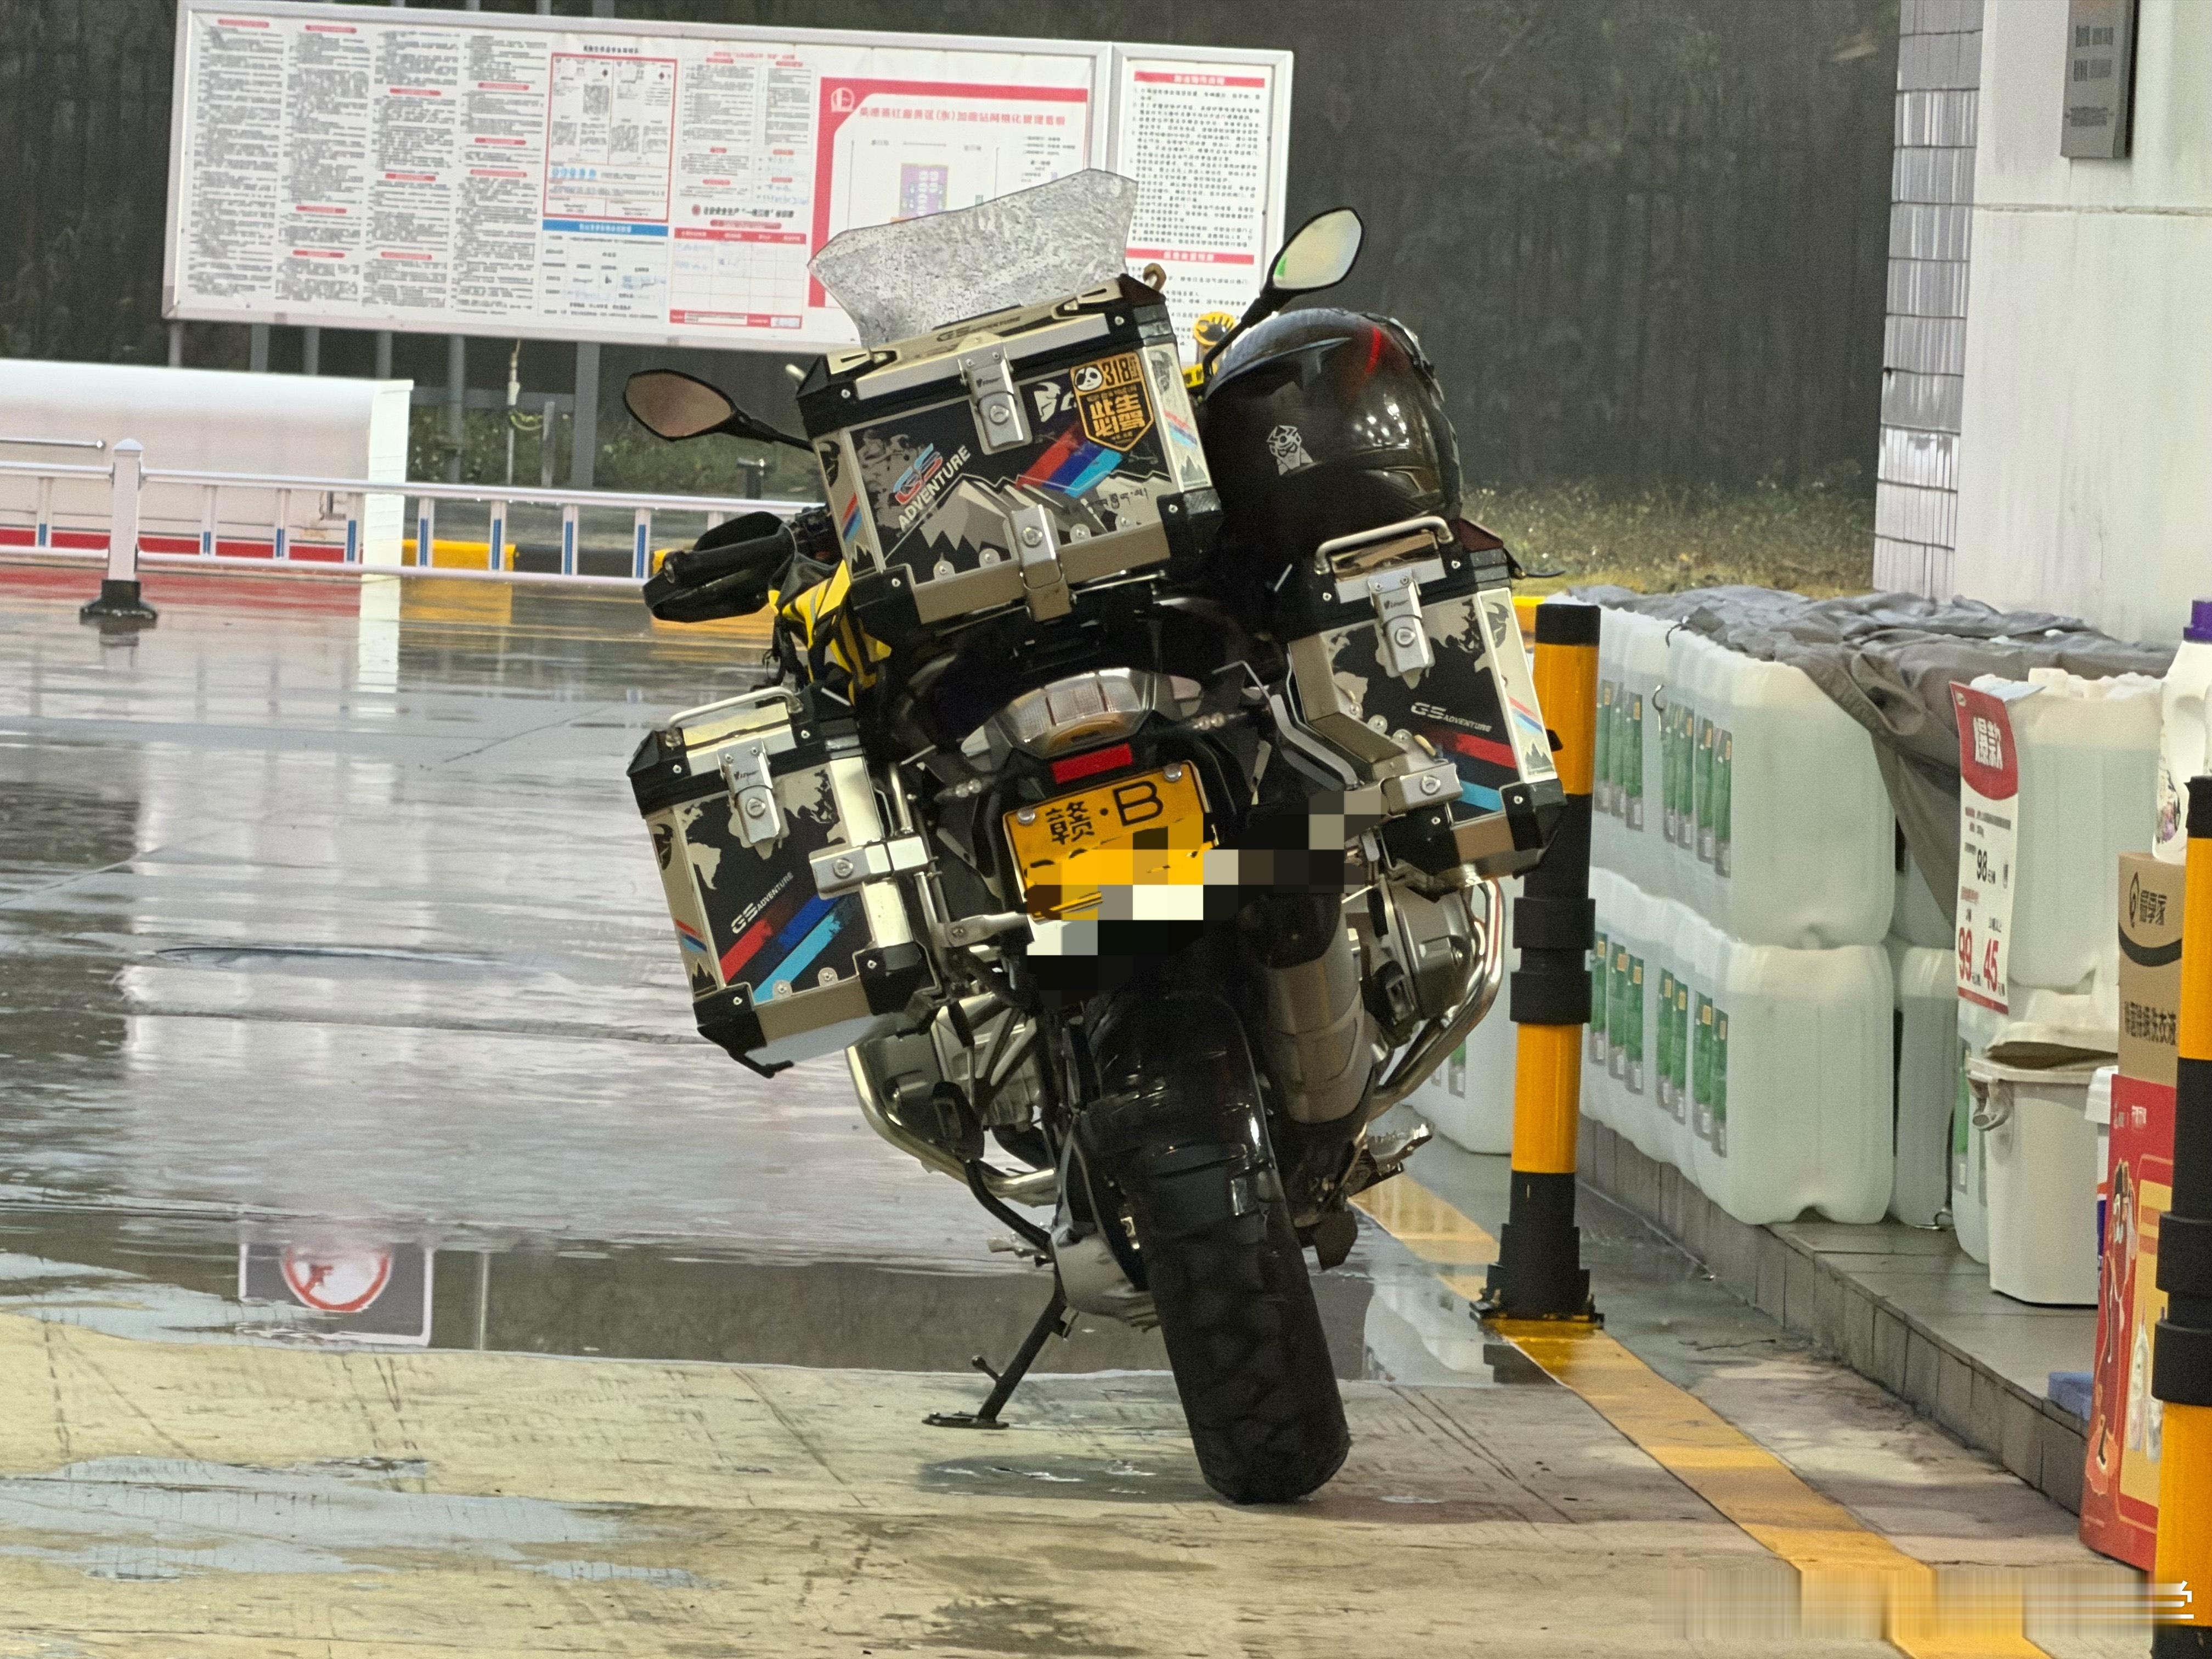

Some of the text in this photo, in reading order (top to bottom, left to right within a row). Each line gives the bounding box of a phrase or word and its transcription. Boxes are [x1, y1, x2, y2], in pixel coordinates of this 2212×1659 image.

[1102, 358, 1132, 386] 318
[898, 445, 971, 533] ADVENTURE
[1443, 714, 1492, 732] ADVENTURE
[1973, 716, 2004, 771] 爆款
[1976, 849, 1988, 882] 98
[757, 871, 794, 910] ADVENTURE
[1959, 926, 1999, 992] 99 45
